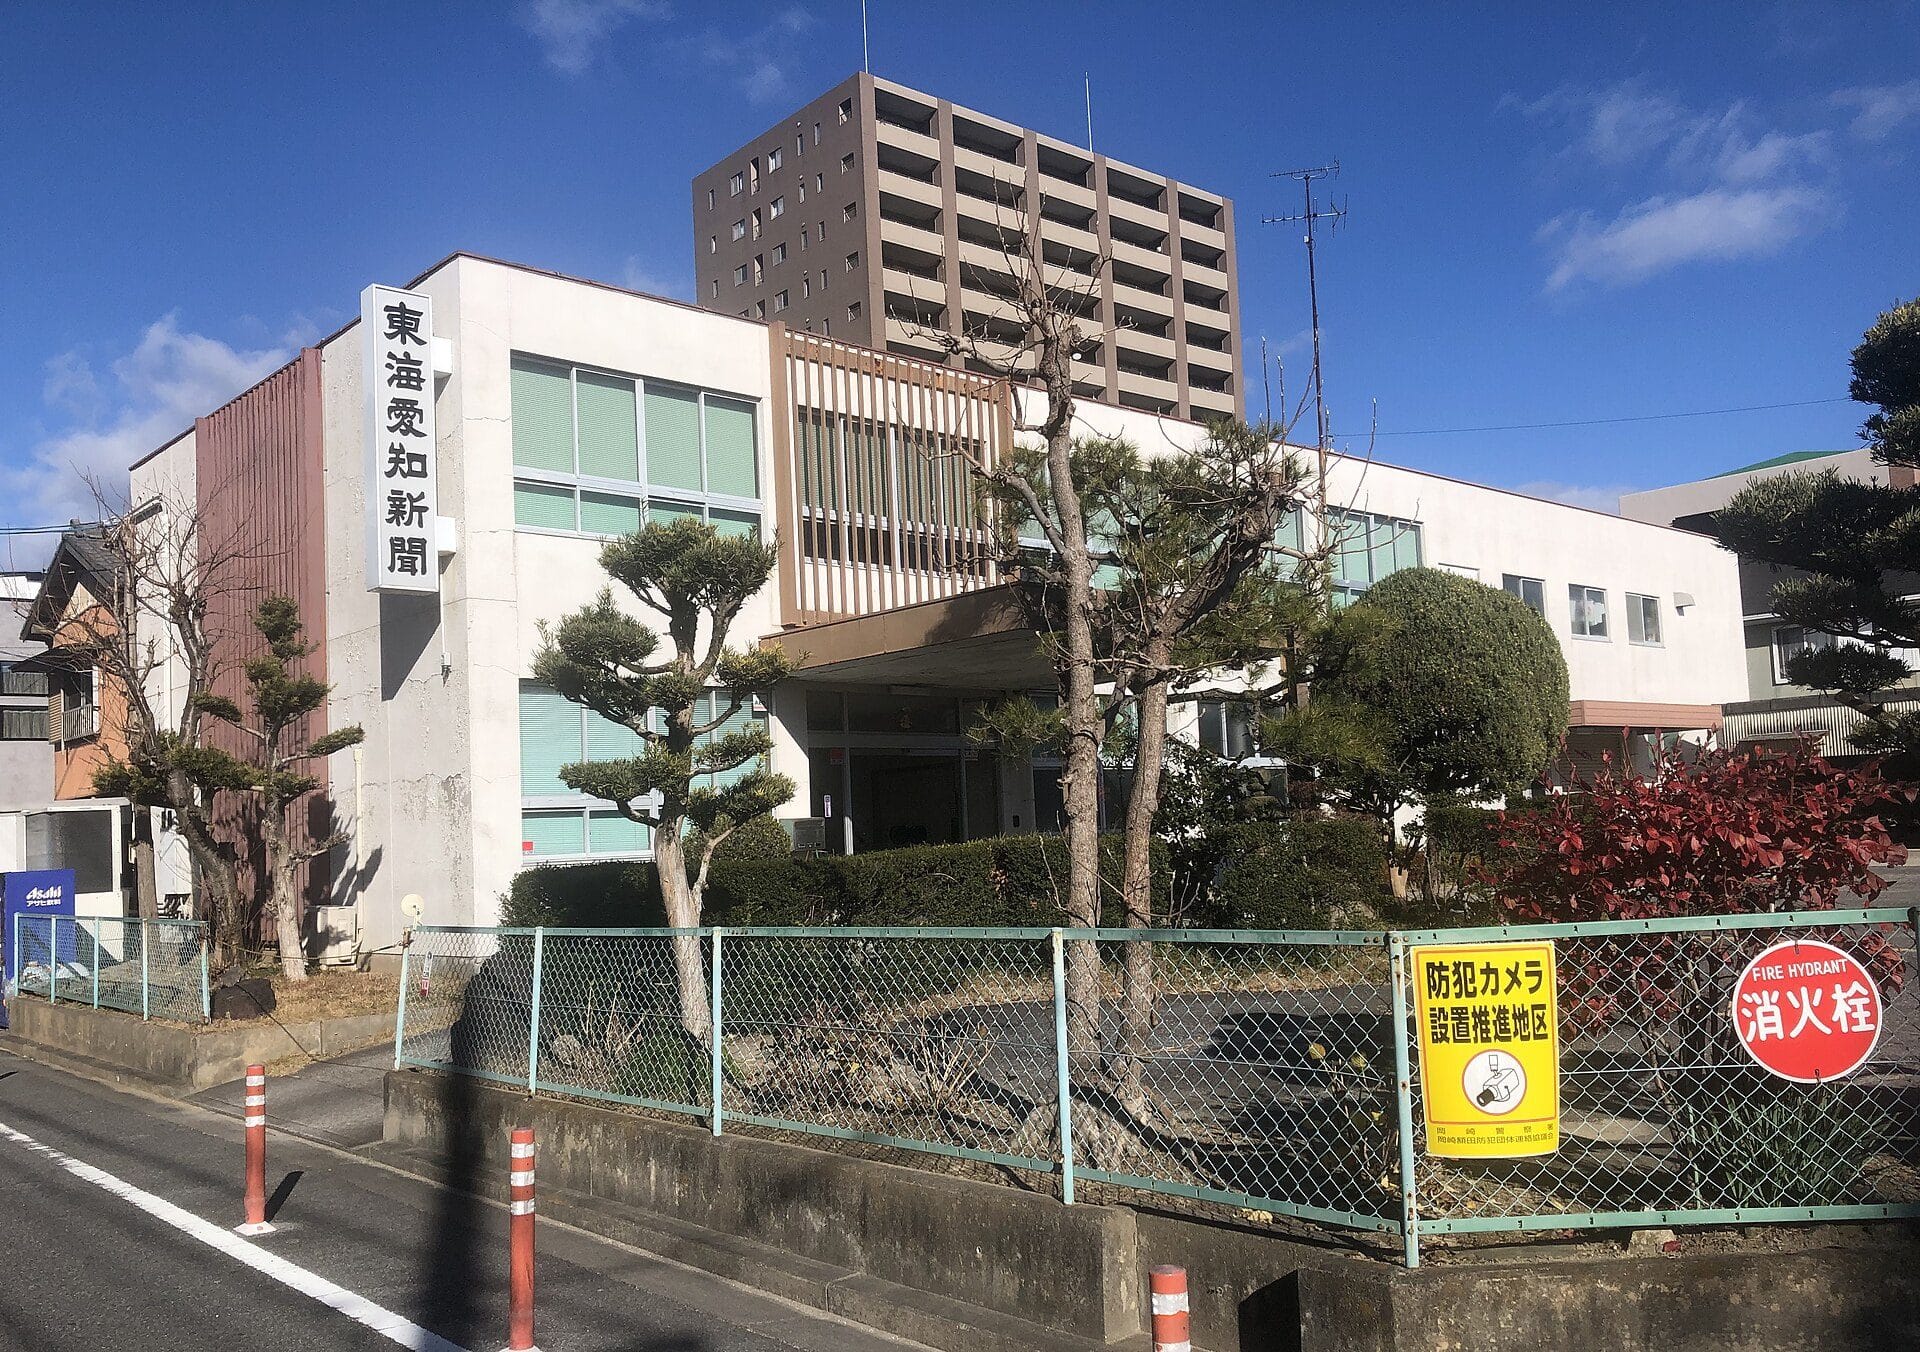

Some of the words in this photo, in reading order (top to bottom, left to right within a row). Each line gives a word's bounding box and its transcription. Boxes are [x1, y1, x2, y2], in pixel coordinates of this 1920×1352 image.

[383, 301, 429, 576] 東海愛知新聞
[26, 885, 62, 900] Asahi
[1426, 960, 1543, 999] 防犯カメラ
[1752, 964, 1785, 982] FIRE
[1788, 958, 1848, 978] HYDRANT
[1430, 1003, 1549, 1044] 設置推進地区
[1741, 980, 1875, 1043] 消火栓
